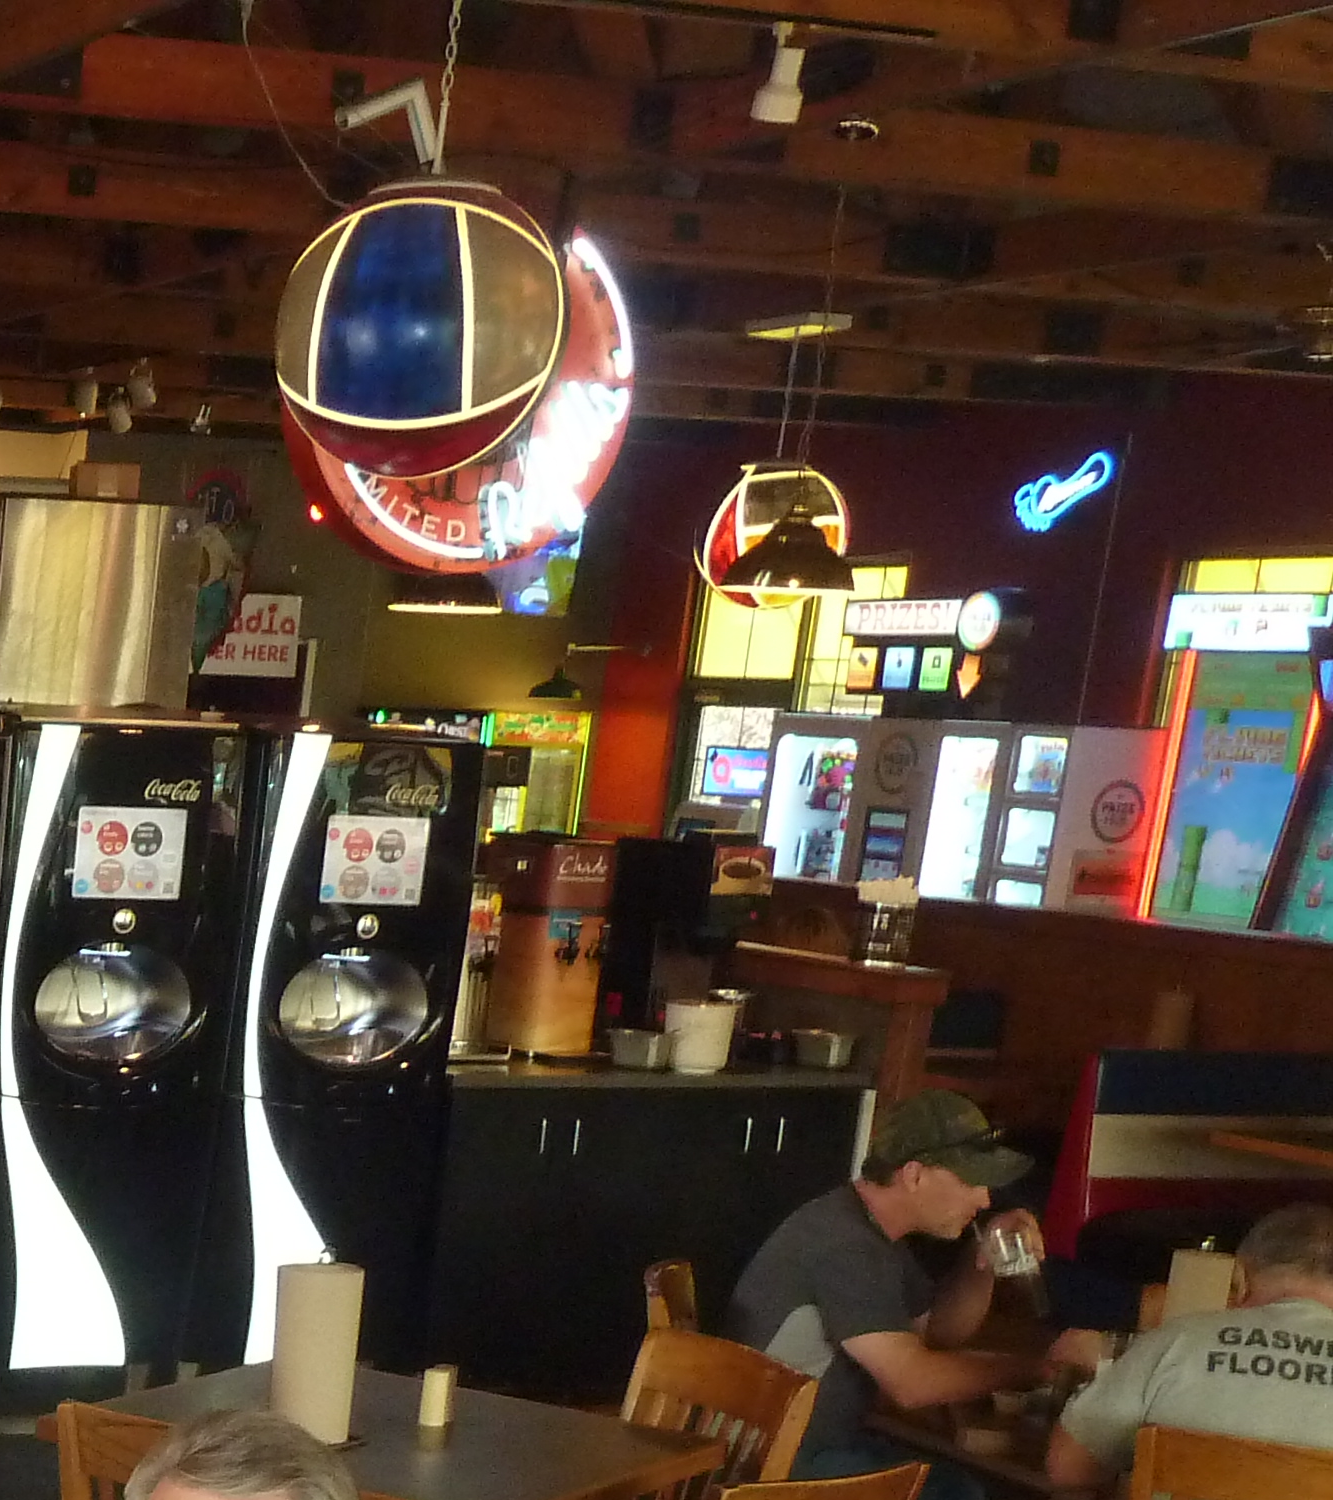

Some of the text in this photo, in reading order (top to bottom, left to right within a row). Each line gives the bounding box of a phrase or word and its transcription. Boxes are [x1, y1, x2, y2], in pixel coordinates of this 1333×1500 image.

[365, 473, 466, 543] MITED
[857, 602, 951, 631] PRIZES!
[207, 644, 289, 663] ER HERE
[1206, 1350, 1333, 1386] FLOOR
